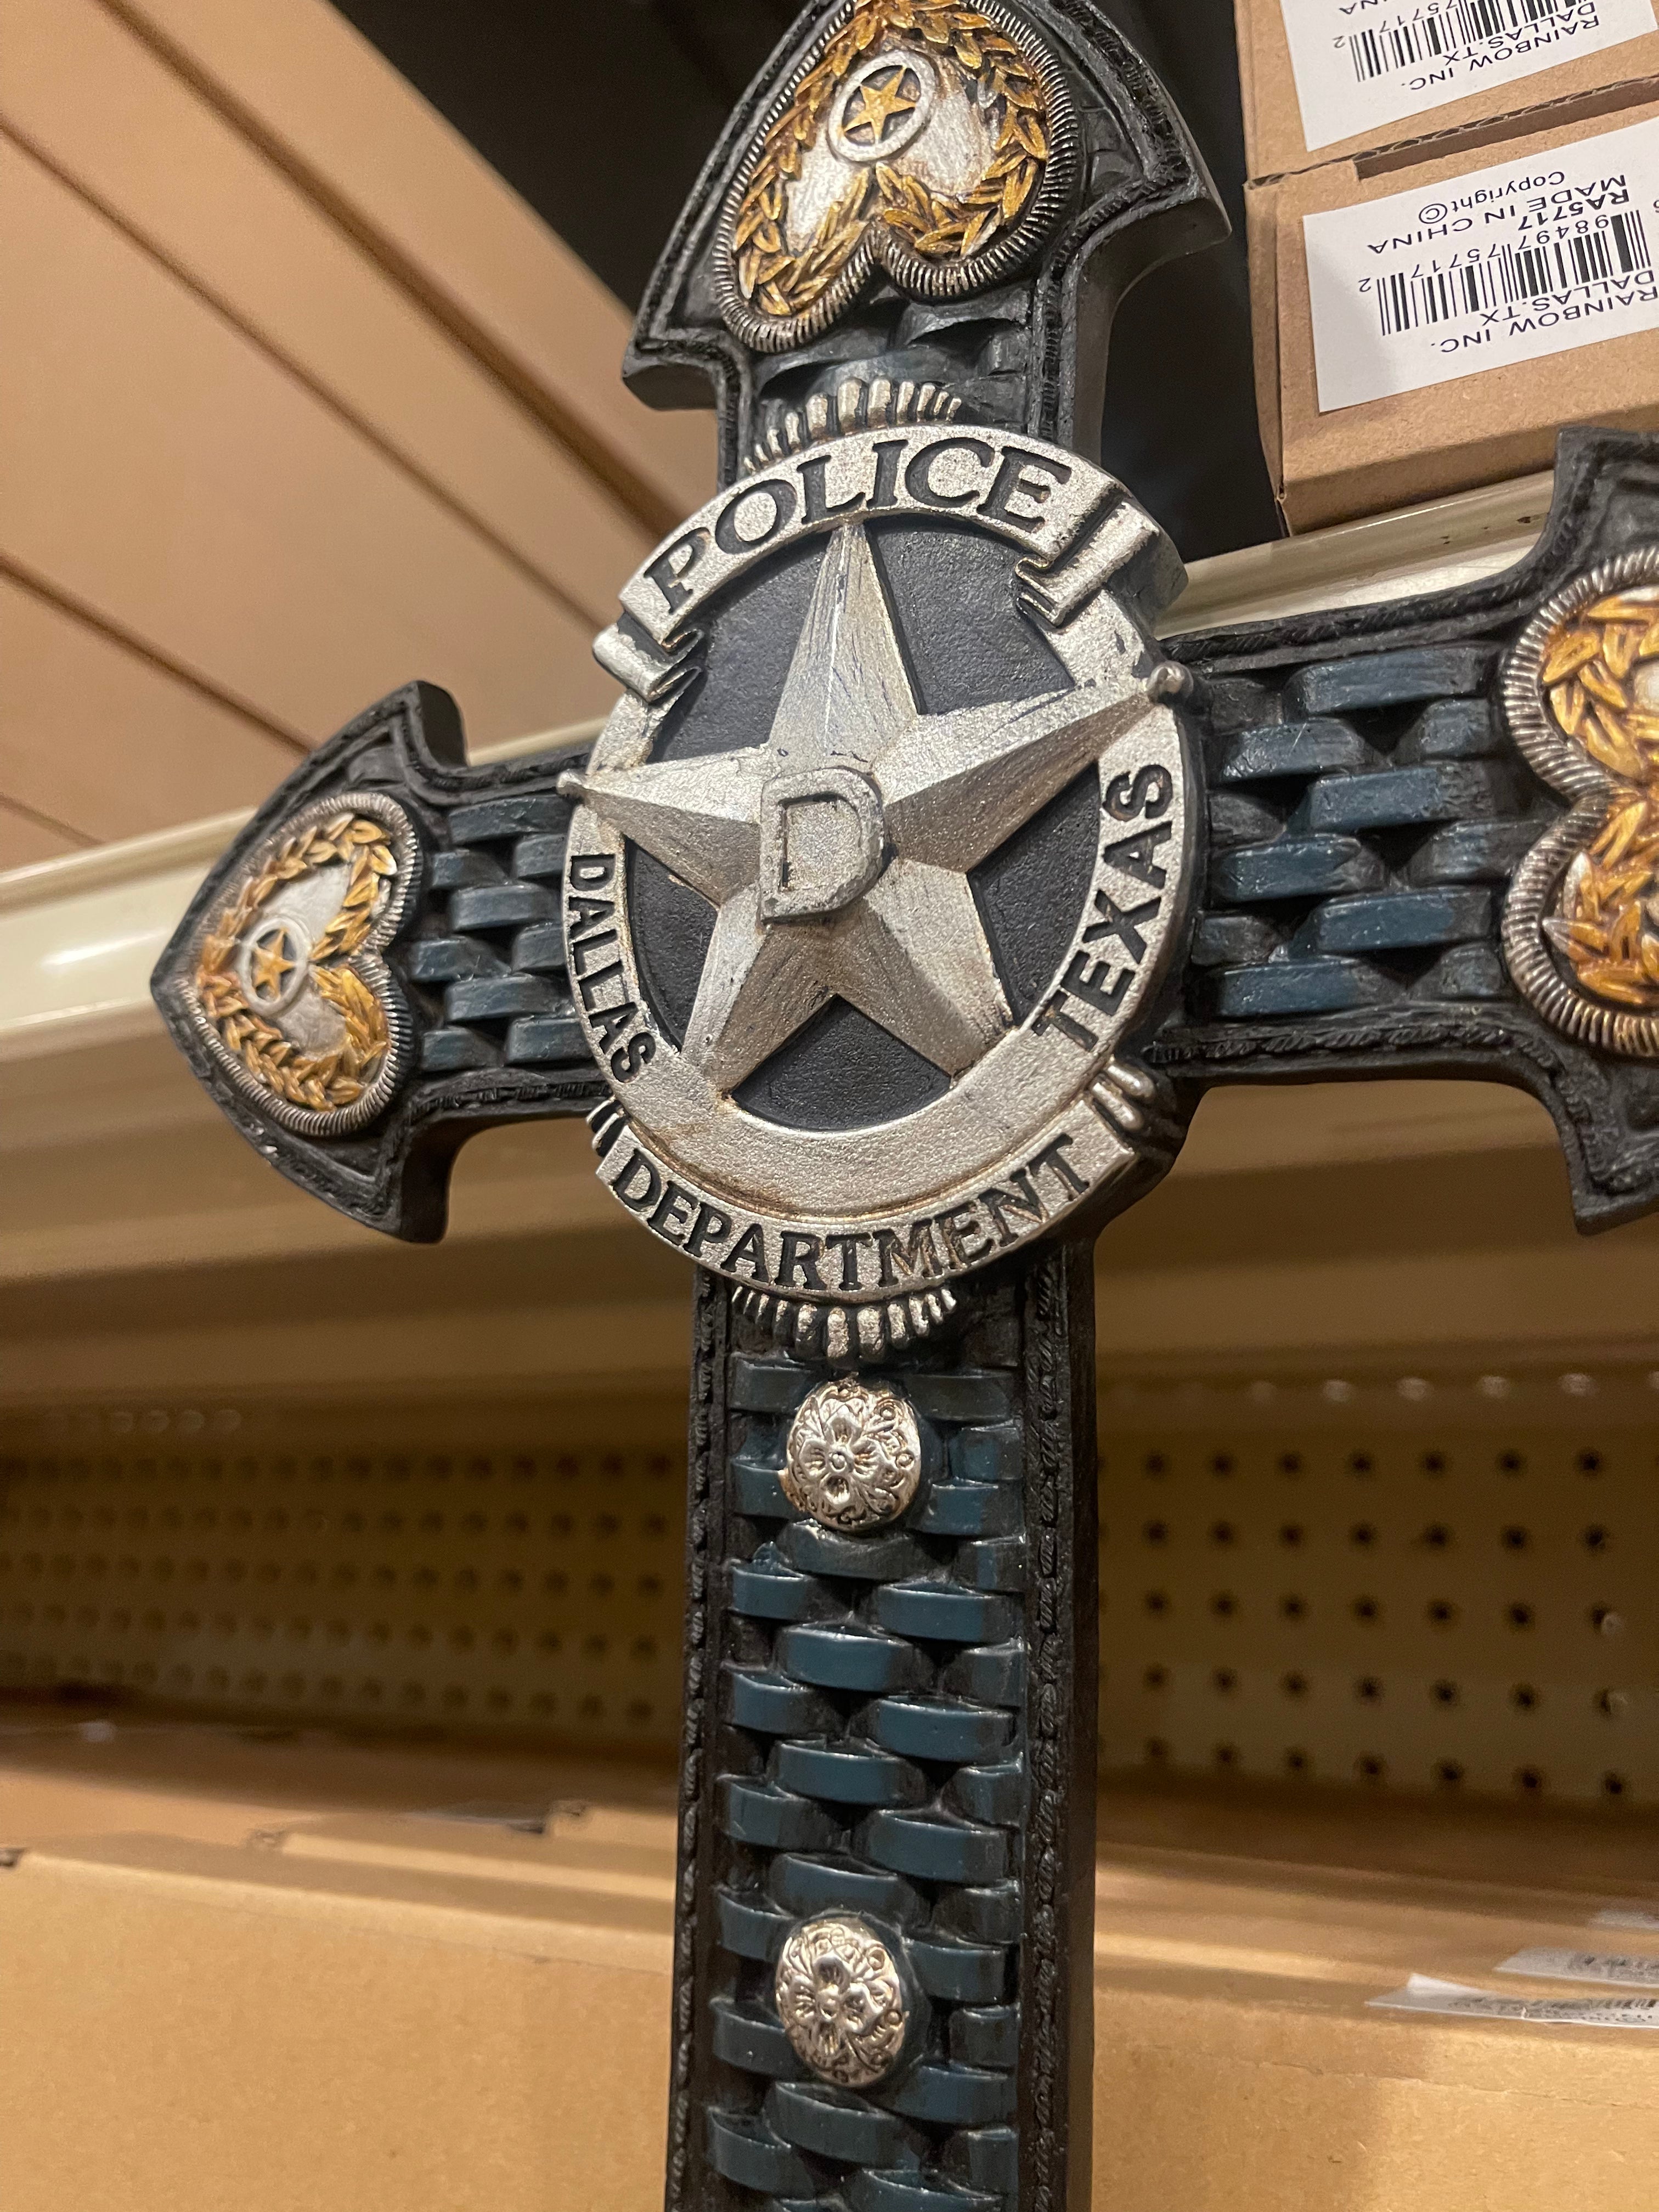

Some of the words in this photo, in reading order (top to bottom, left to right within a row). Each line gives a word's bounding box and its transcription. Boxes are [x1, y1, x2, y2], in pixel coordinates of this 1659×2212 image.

[1469, 15, 1600, 72] RAINBOW
[1401, 67, 1453, 91] INC.
[1485, 205, 1515, 223] IN
[1518, 189, 1629, 231] RA5717
[1526, 175, 1627, 213] MADE
[1368, 218, 1473, 253] CHINA
[1518, 215, 1609, 250] 98497
[1411, 244, 1500, 279] 75717
[1509, 286, 1658, 336] RAINBOW
[1431, 329, 1491, 353] INC.
[644, 437, 1071, 614] POLICE
[759, 766, 885, 926] D
[1031, 764, 1173, 1052] TEXAS
[569, 854, 656, 1084] DALLAS
[612, 1133, 1091, 1291] DEPARTMENT
